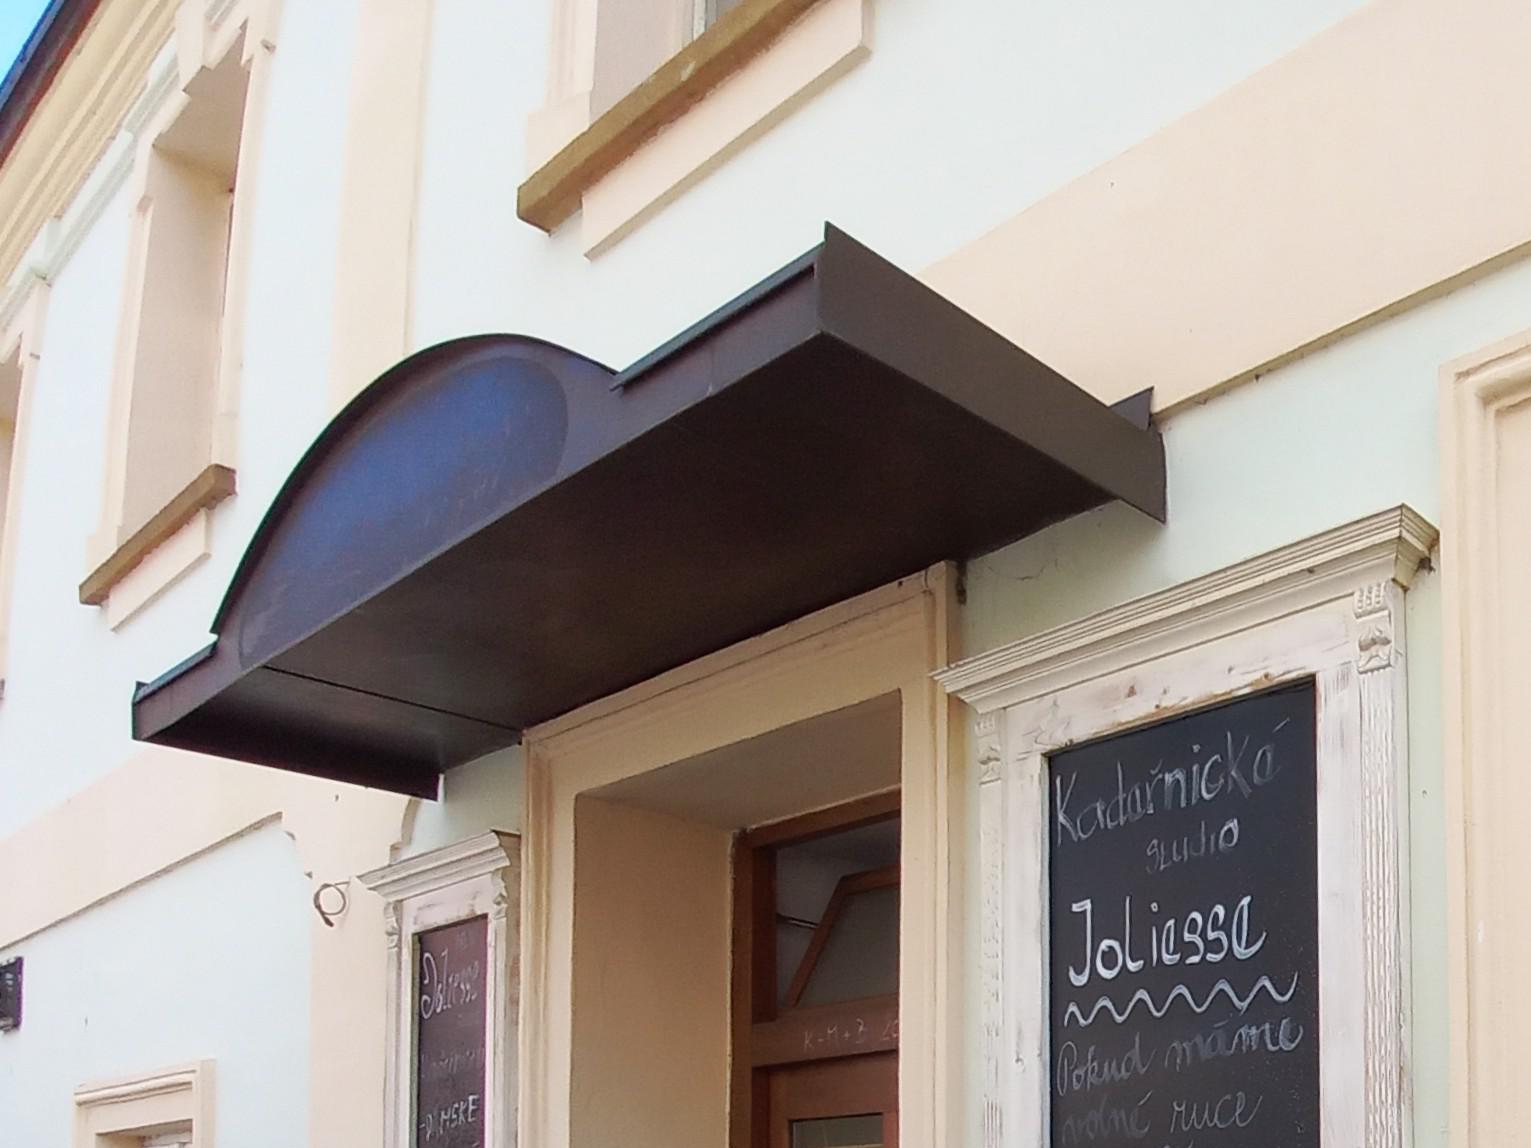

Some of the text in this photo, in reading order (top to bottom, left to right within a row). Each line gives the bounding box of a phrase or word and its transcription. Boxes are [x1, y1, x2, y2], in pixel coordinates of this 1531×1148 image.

[1056, 1018, 1304, 1096] Pokud máme
[1170, 1091, 1264, 1134] ruce
